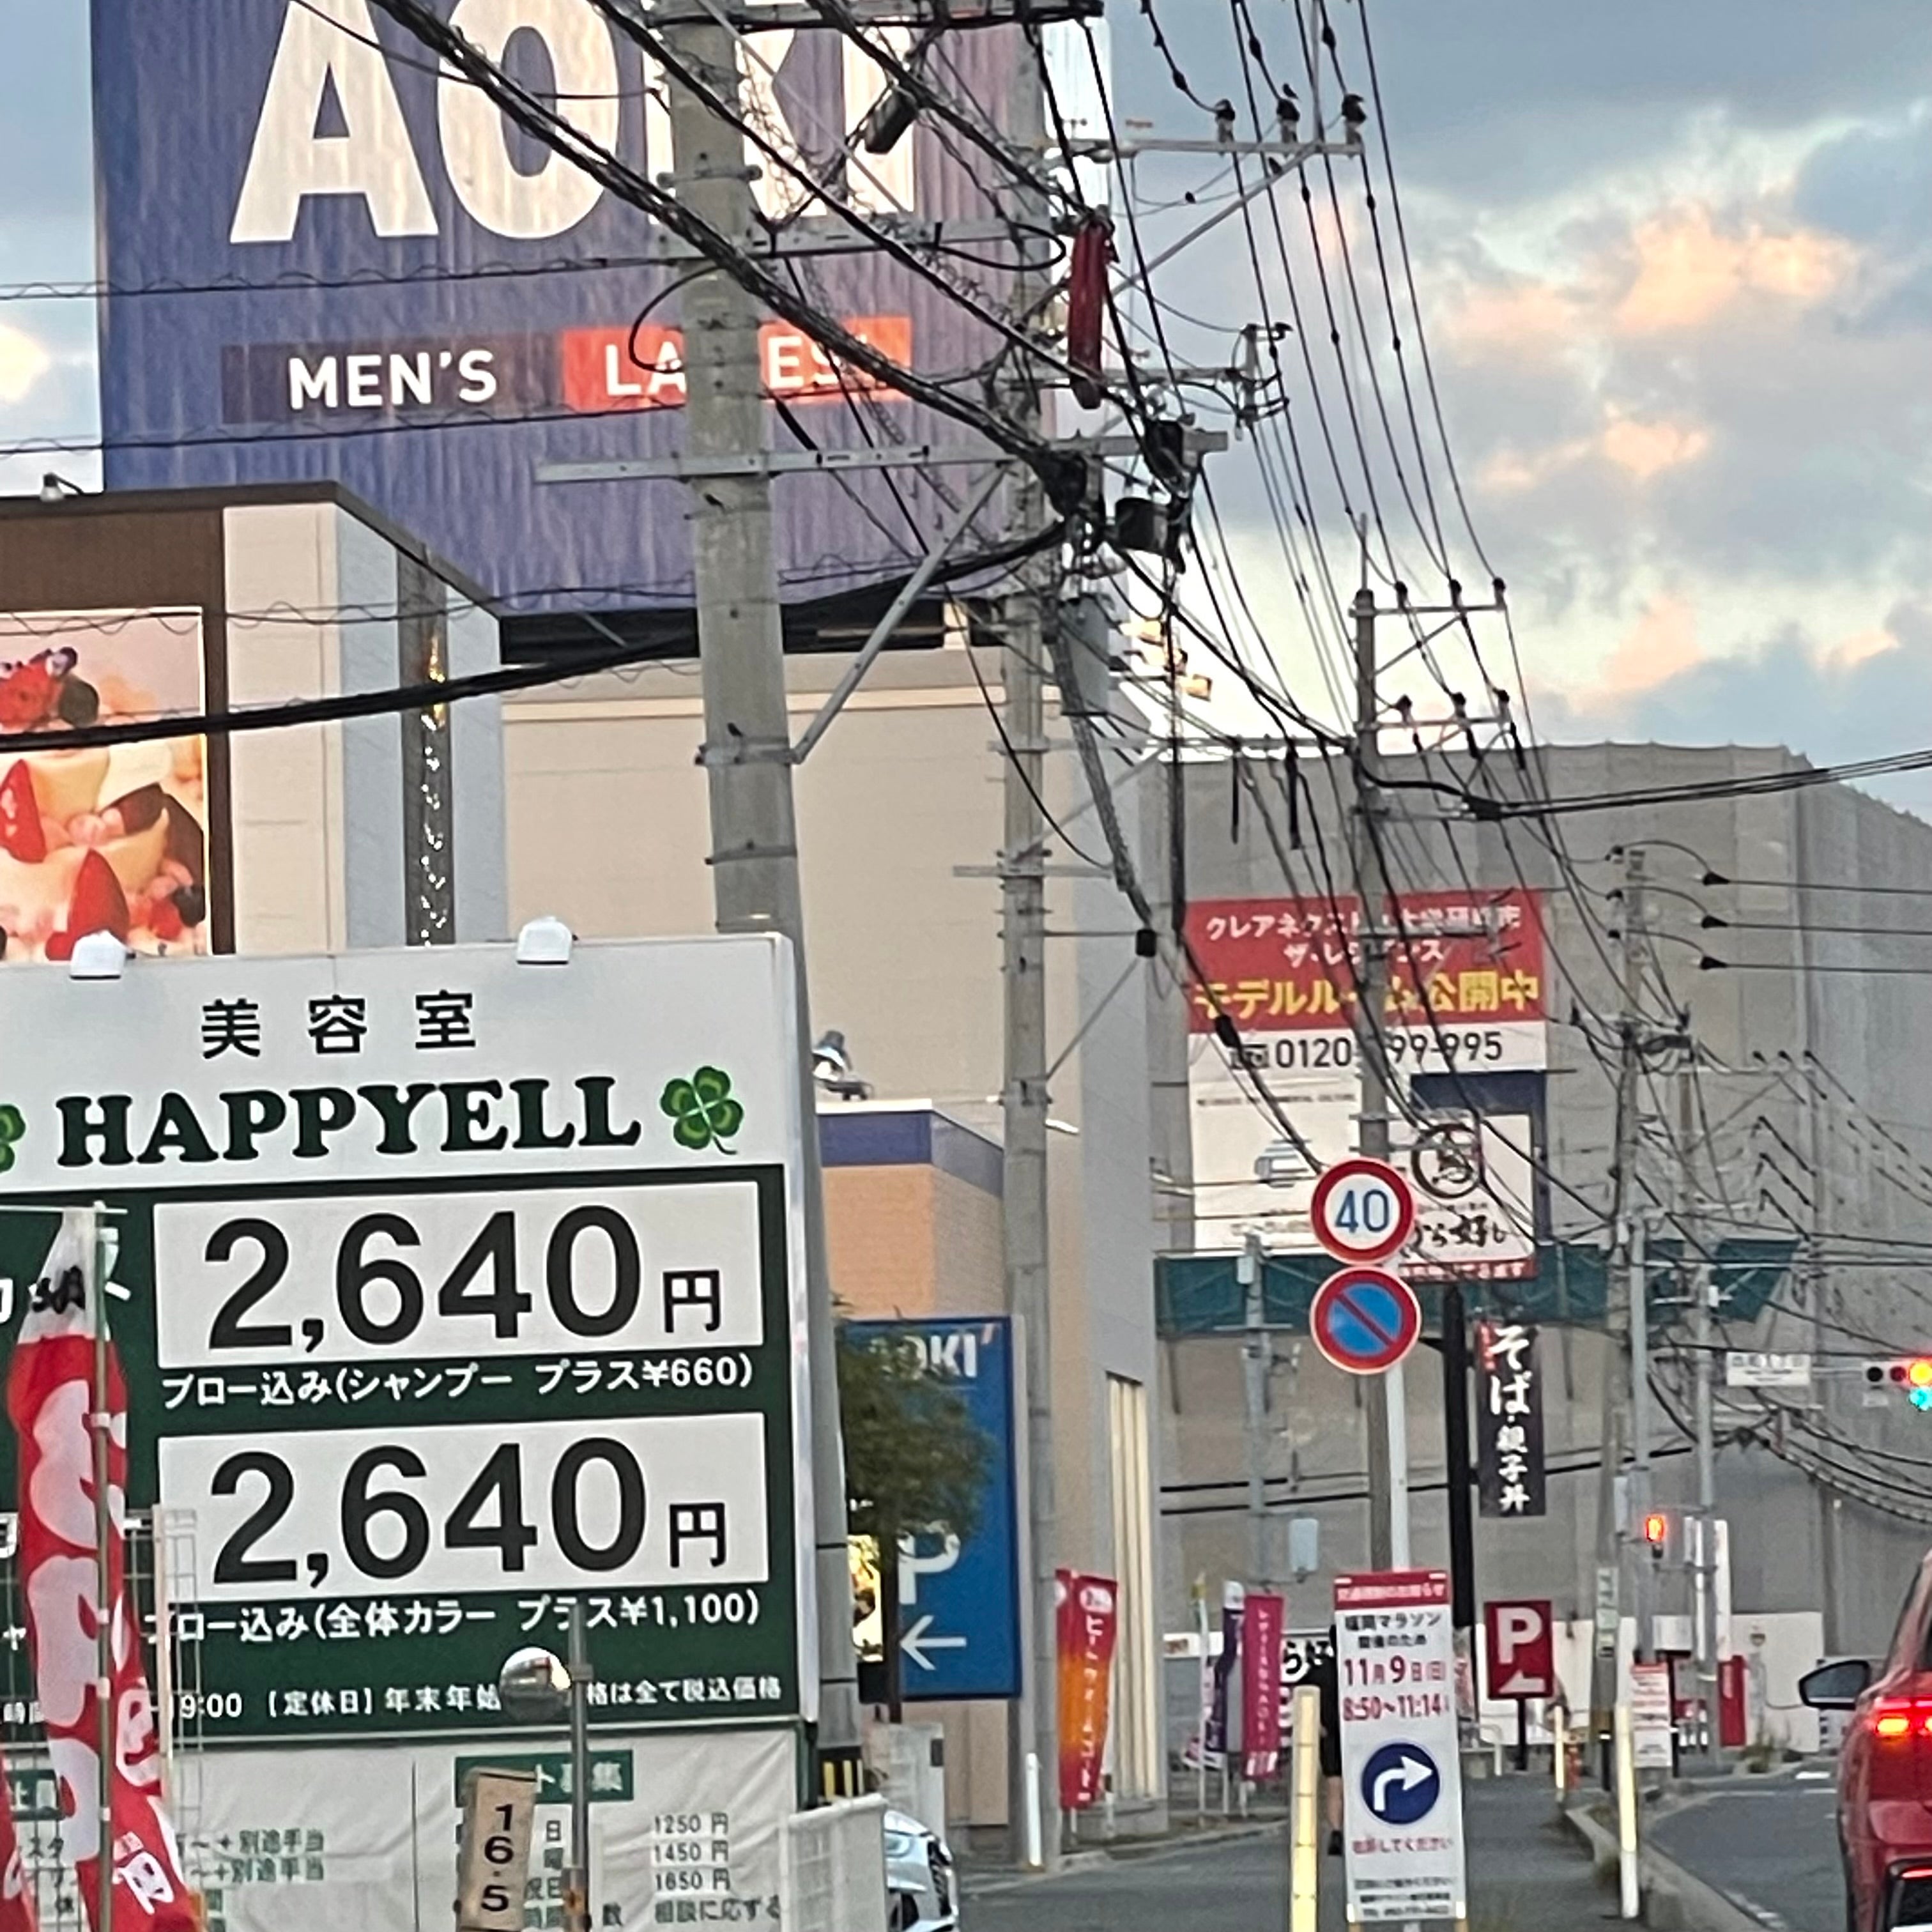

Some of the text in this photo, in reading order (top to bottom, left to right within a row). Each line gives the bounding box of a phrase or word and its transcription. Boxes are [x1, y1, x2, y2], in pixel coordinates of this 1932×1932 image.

[288, 334, 867, 410] MEN'S LAES
[1193, 969, 1538, 1019] モデルルム公開中
[201, 990, 477, 1060] 美容室
[1276, 1031, 1502, 1068] 012099-995
[55, 1075, 643, 1169] HAPPYELL
[1335, 1189, 1390, 1234] 40
[898, 1521, 960, 1605] P
[1497, 1607, 1544, 1666] P
[565, 1675, 781, 1706] 格は全て税込価格
